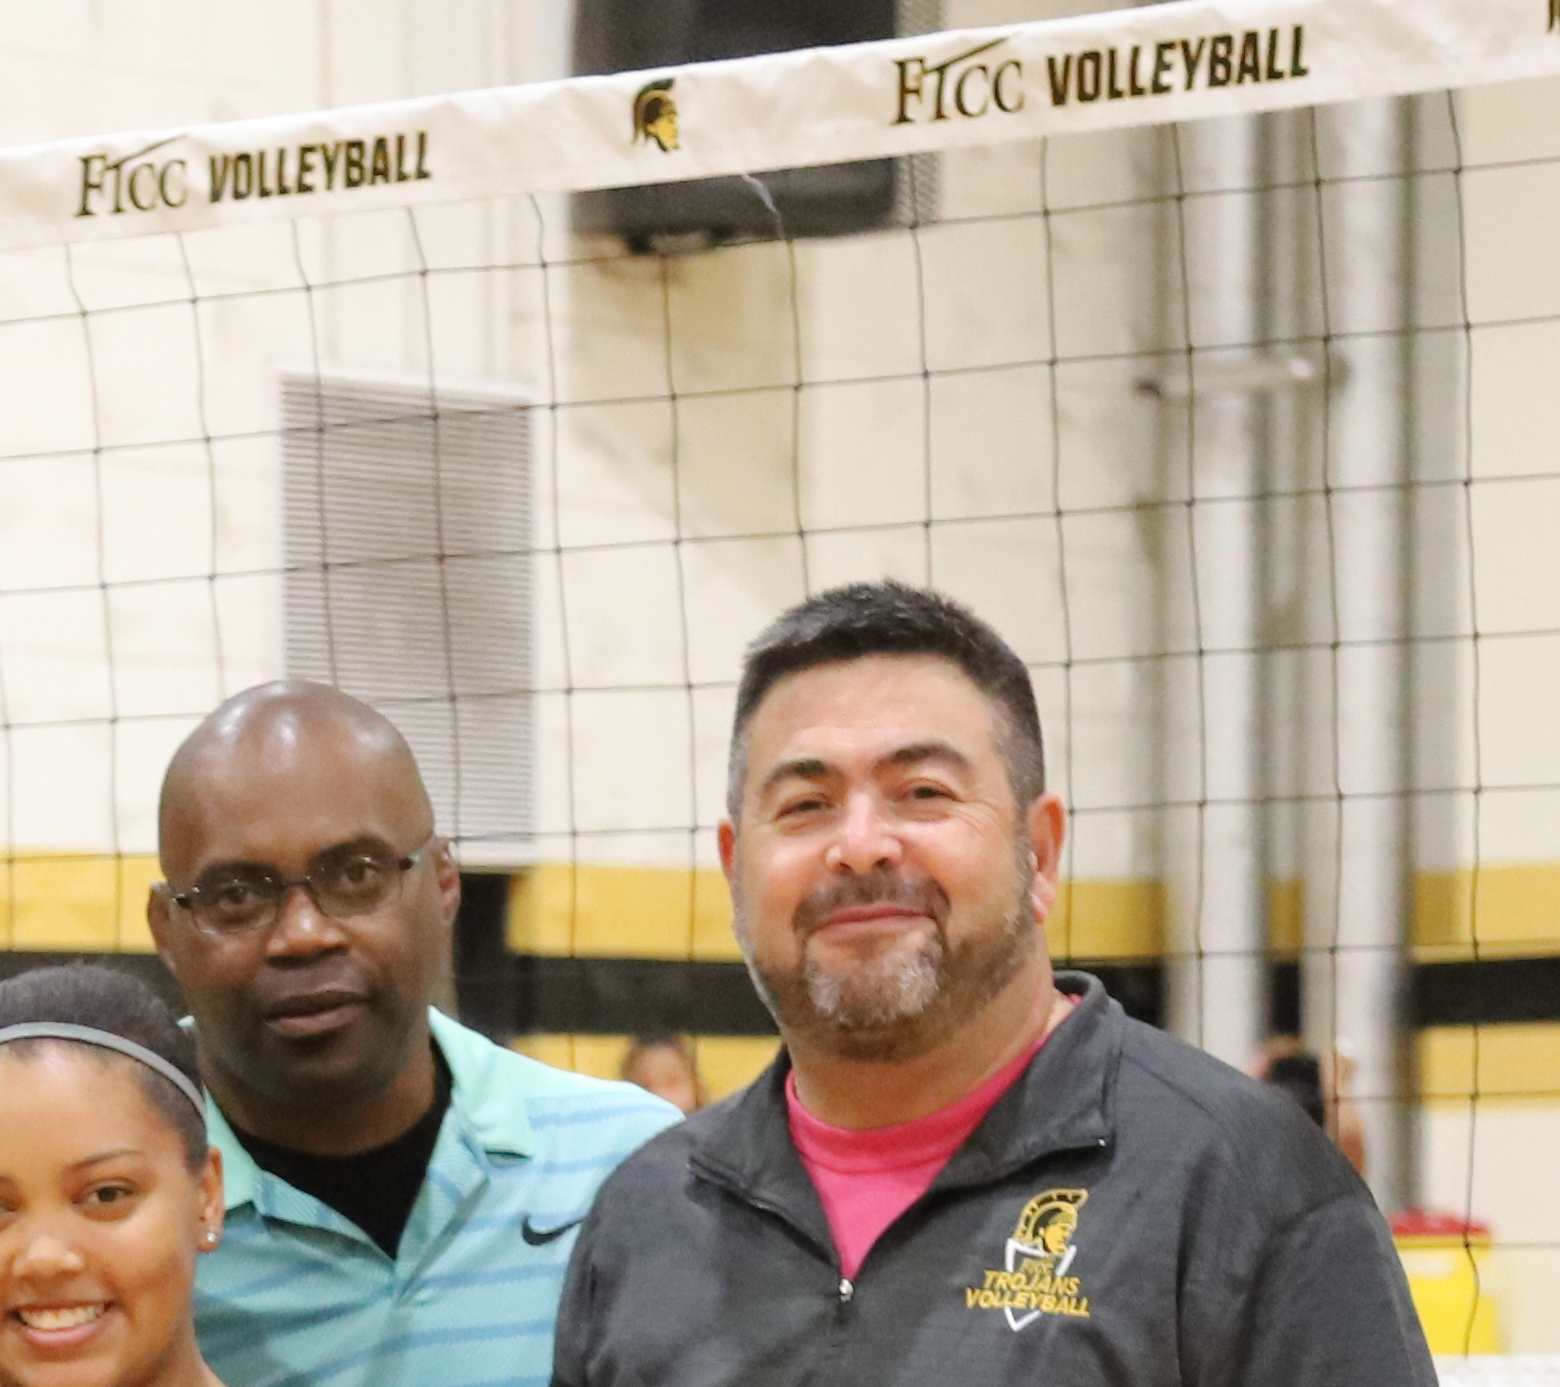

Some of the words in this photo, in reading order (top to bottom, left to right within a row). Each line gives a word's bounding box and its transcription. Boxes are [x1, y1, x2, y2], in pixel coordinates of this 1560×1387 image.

[890, 37, 1025, 125] FTCC
[1044, 23, 1309, 108] VOLLEYBALL
[74, 132, 187, 218] FTCC
[208, 131, 433, 203] VOLLEYBALL
[964, 1286, 1091, 1318] VOLLEYBALL
[982, 1269, 1082, 1296] TROJANS
